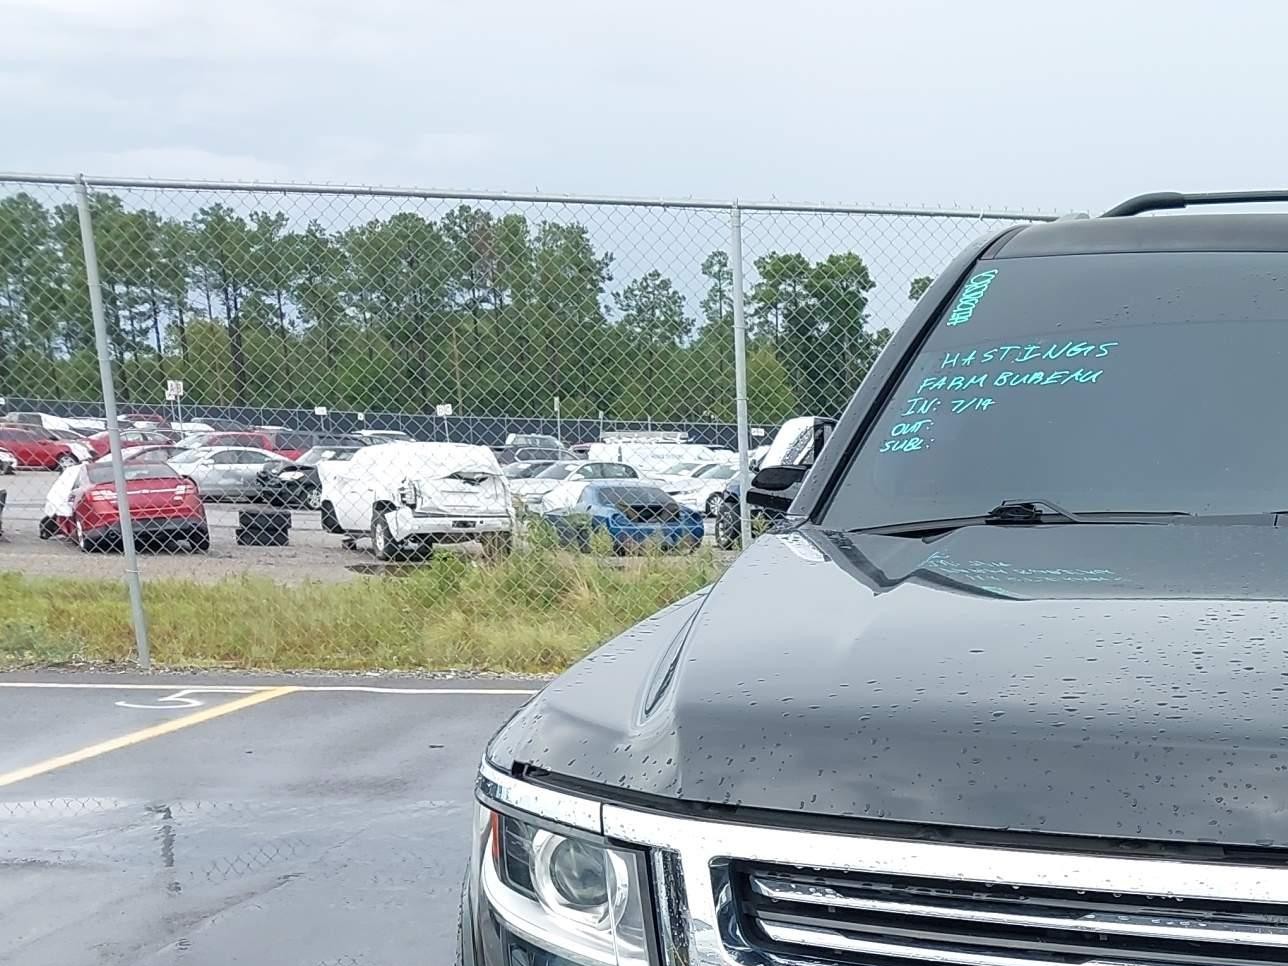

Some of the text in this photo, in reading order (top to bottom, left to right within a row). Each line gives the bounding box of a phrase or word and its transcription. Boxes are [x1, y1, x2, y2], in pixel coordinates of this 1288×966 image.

[941, 342, 1118, 369] HASTINGS
[901, 397, 941, 417] IN:
[891, 419, 935, 437] OUT:
